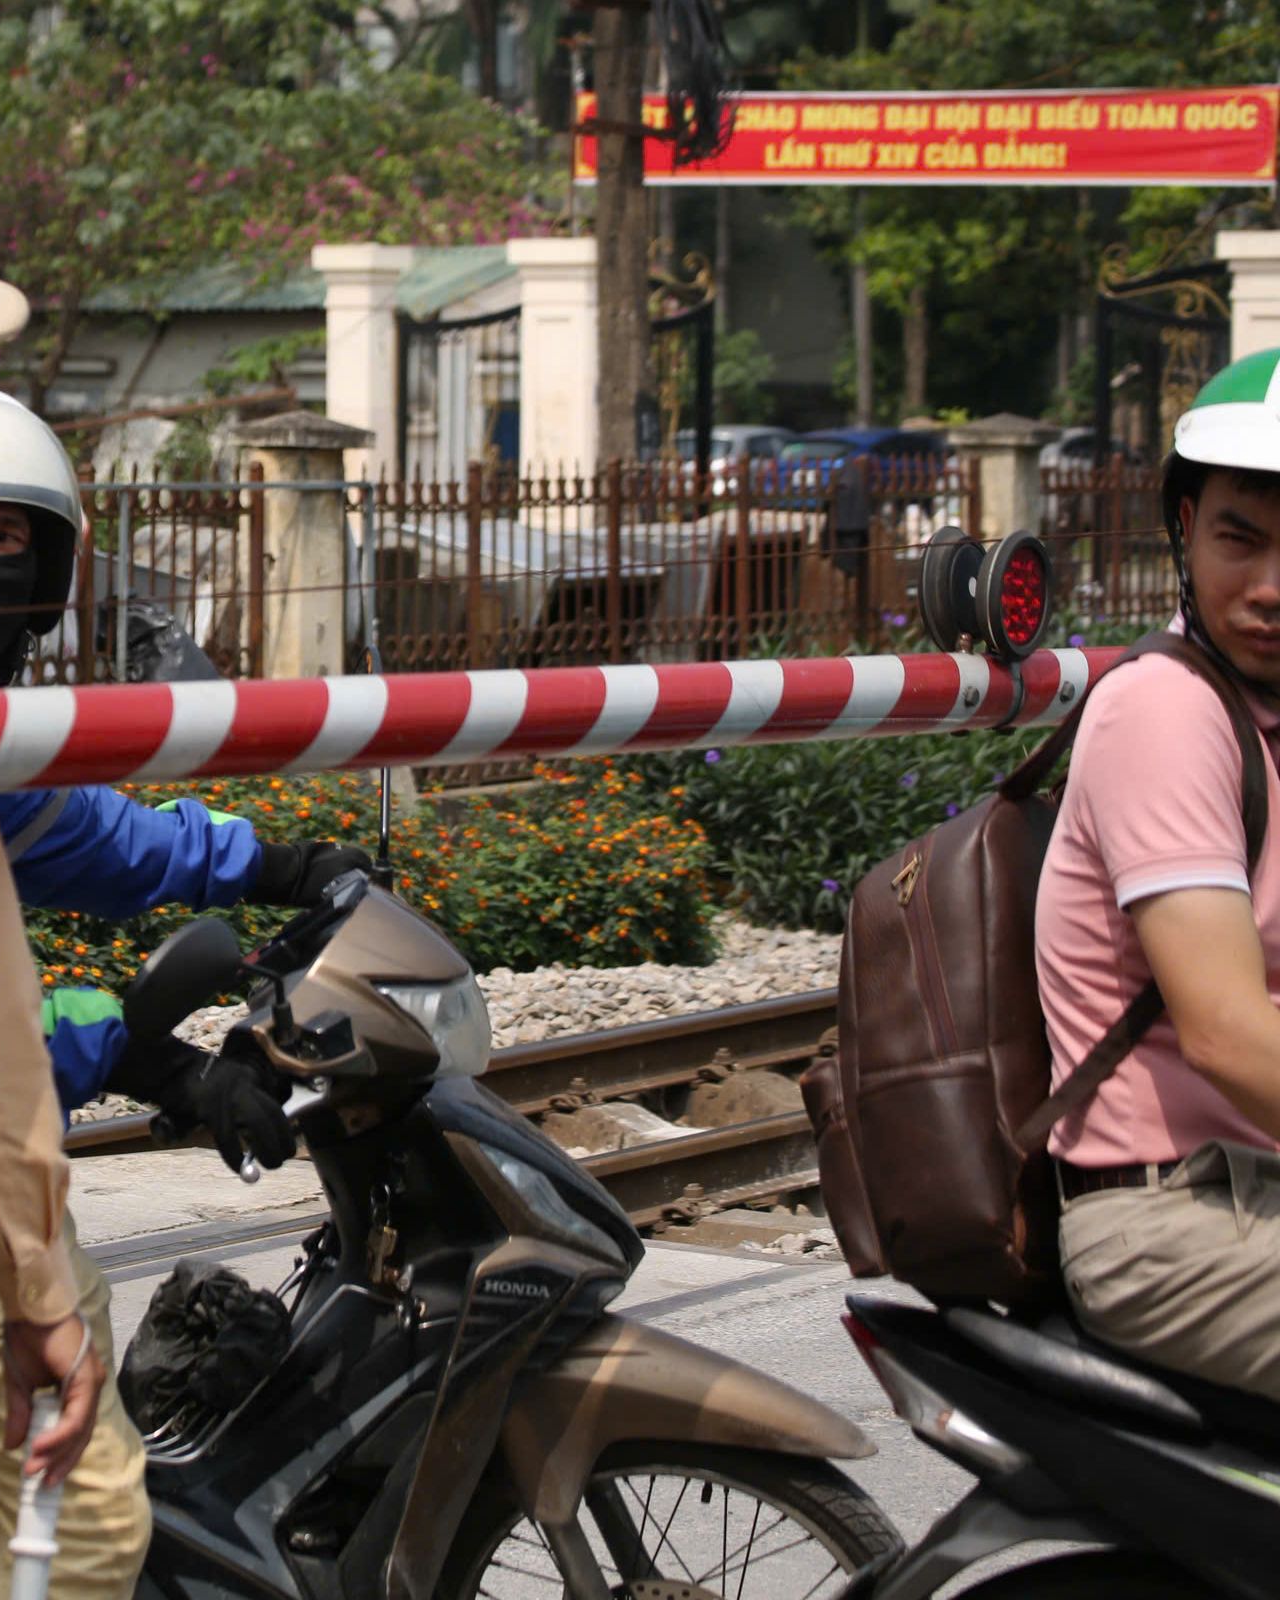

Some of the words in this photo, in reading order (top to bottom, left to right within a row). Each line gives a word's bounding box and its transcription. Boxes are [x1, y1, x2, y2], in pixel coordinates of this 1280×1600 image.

[935, 101, 980, 135] HỘI
[1183, 96, 1258, 132] QUỐC
[876, 143, 919, 168] XIV
[484, 1279, 550, 1298] HONDA
